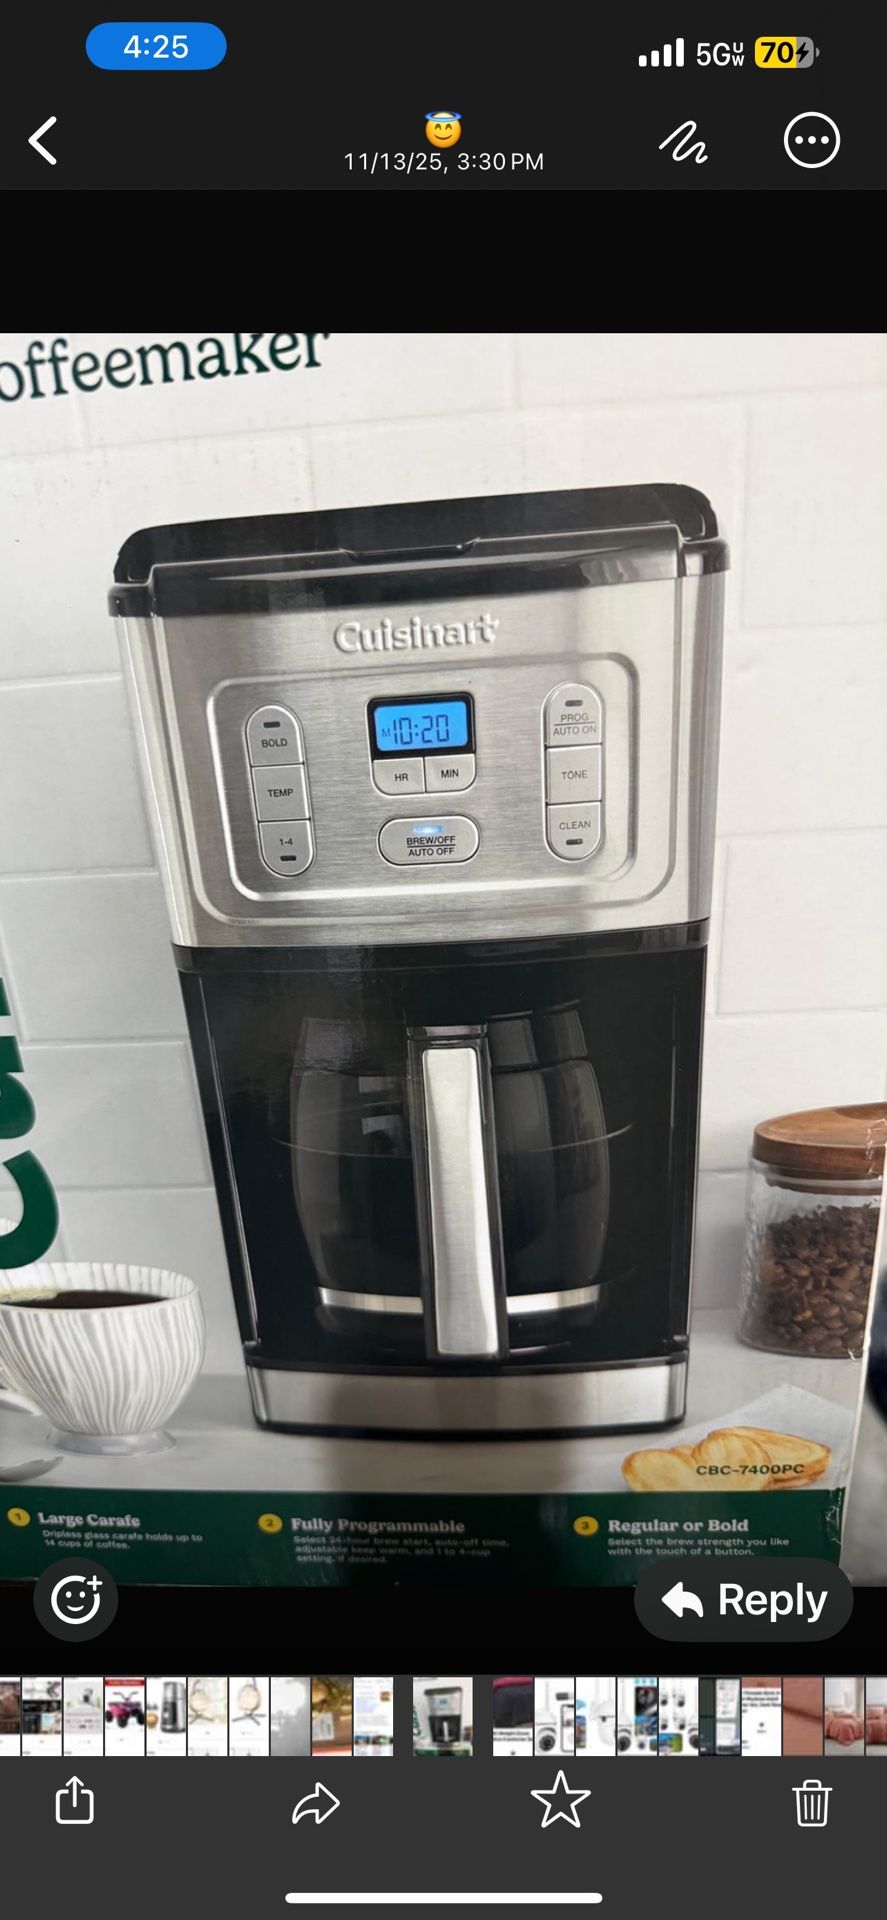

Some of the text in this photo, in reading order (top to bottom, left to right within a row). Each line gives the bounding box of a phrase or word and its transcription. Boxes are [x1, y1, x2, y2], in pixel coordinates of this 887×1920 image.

[334, 613, 499, 653] Cuisinart
[560, 713, 589, 723] PROG
[393, 714, 450, 745] 10:20
[553, 725, 597, 736] AUTO ON
[261, 738, 288, 748] BOLD
[394, 773, 409, 782] HR
[441, 768, 459, 779] MIN
[561, 770, 589, 780] TONE
[267, 788, 294, 798] TEMP
[559, 820, 591, 831] CLEAN
[279, 837, 293, 846] 1-4
[406, 835, 456, 846] BREW/OFF
[408, 846, 455, 857] AUTO OFF
[696, 1463, 805, 1476] CBC-7400PC
[38, 1511, 141, 1528] Large Carafe
[266, 1518, 274, 1527] 2
[291, 1517, 465, 1534] Fully Programmable
[581, 1521, 589, 1530] 3
[608, 1519, 749, 1535] Regular or Bold
[42, 1529, 203, 1543] Dripless glass carafe holds up to
[293, 1535, 327, 1544] Select
[373, 1536, 400, 1545] brew
[58, 1540, 82, 1549] cups
[83, 1539, 94, 1548] of
[96, 1540, 131, 1549] coffee.
[607, 1537, 790, 1548] Select the brew strength you like
[295, 1545, 348, 1554] adjustable
[351, 1545, 376, 1555] keep
[414, 1547, 434, 1555] and
[444, 1547, 457, 1556] to
[607, 1547, 755, 1556] with the touch of a button.
